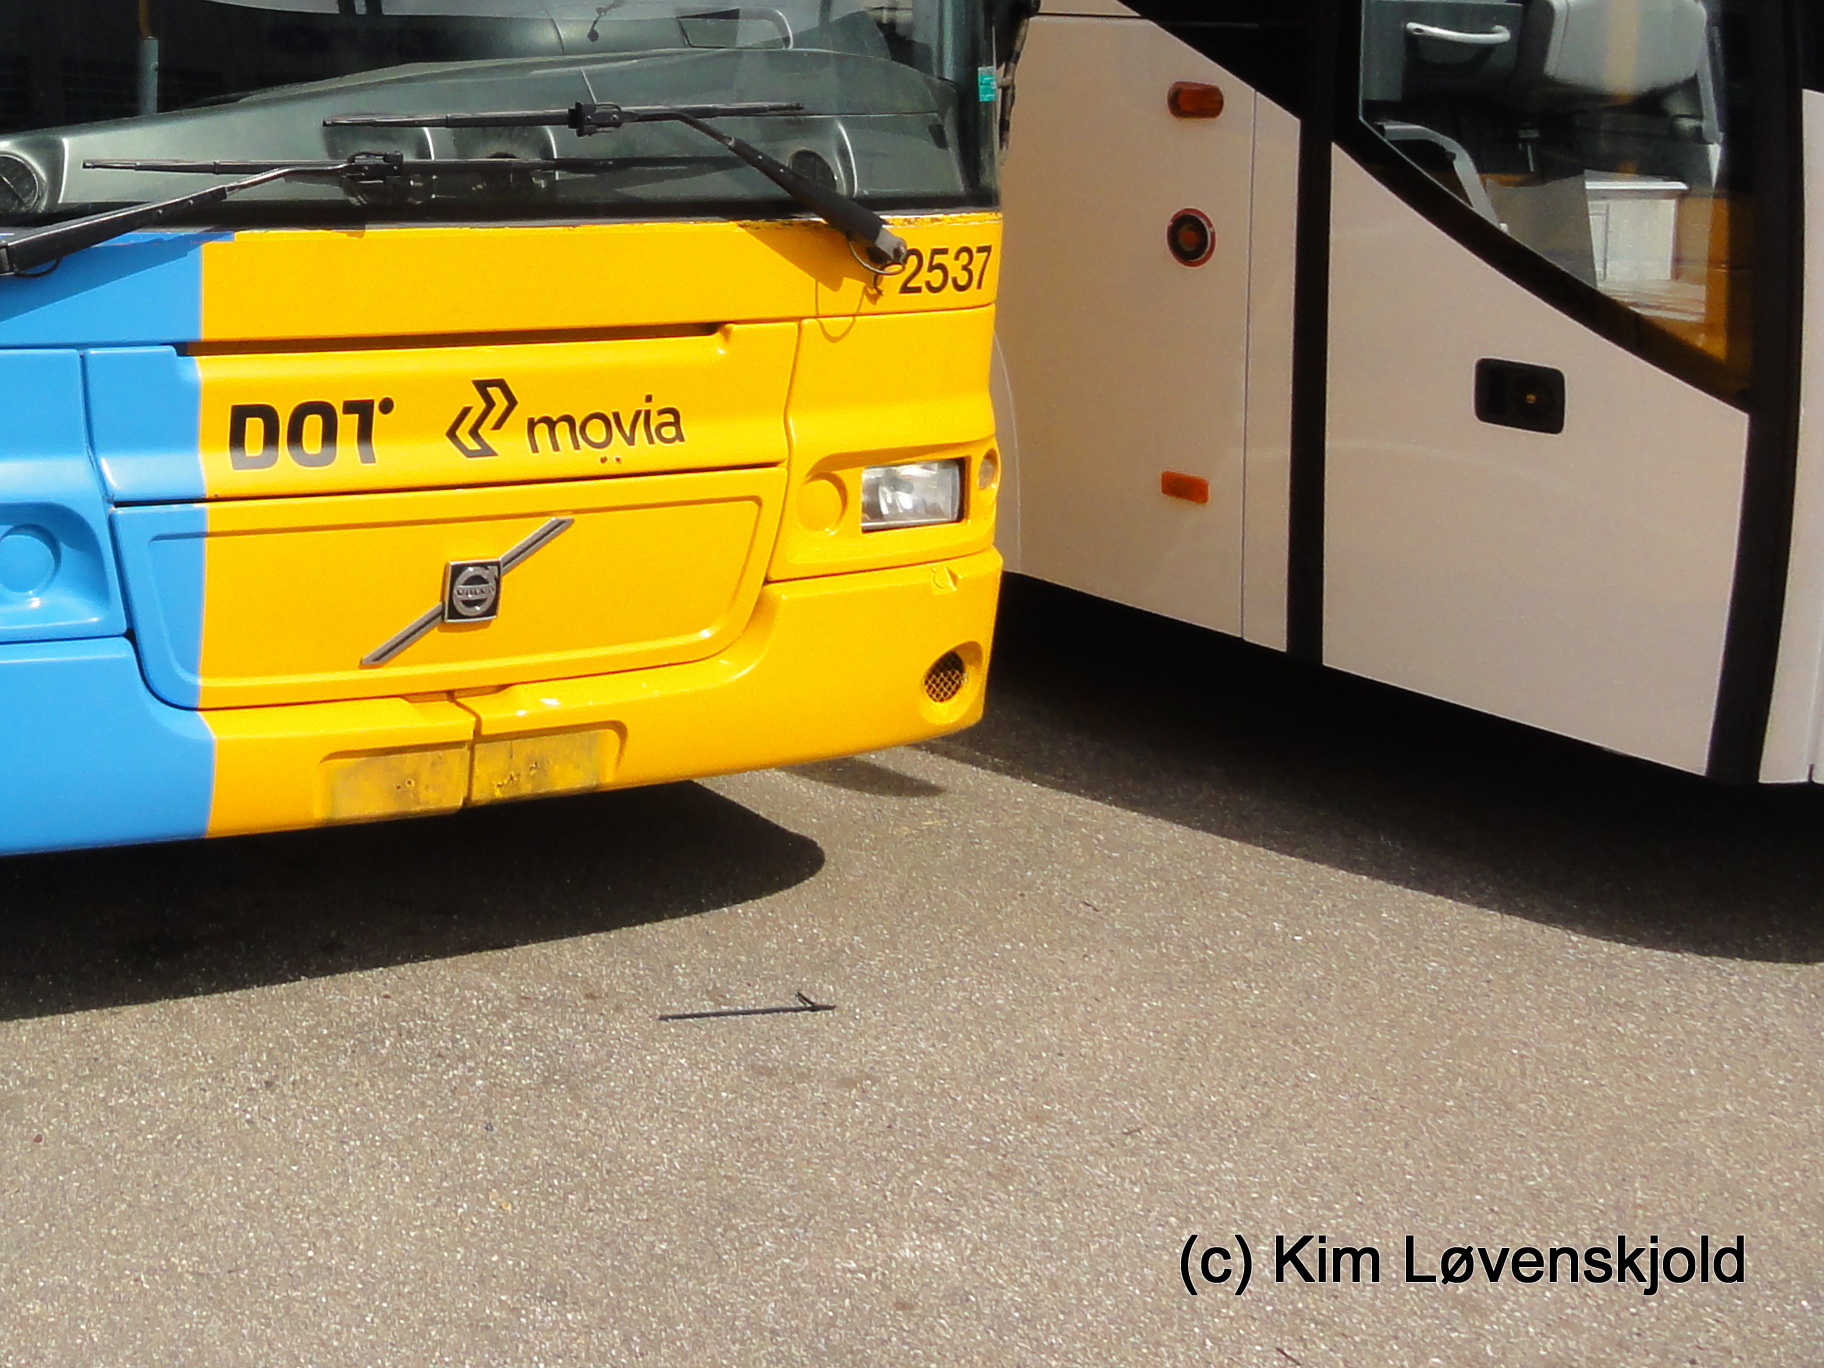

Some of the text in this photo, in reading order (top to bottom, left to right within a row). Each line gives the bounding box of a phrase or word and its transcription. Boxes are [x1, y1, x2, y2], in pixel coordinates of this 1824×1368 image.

[898, 244, 992, 294] 2537
[228, 396, 395, 471] DOT
[526, 394, 685, 454] movia
